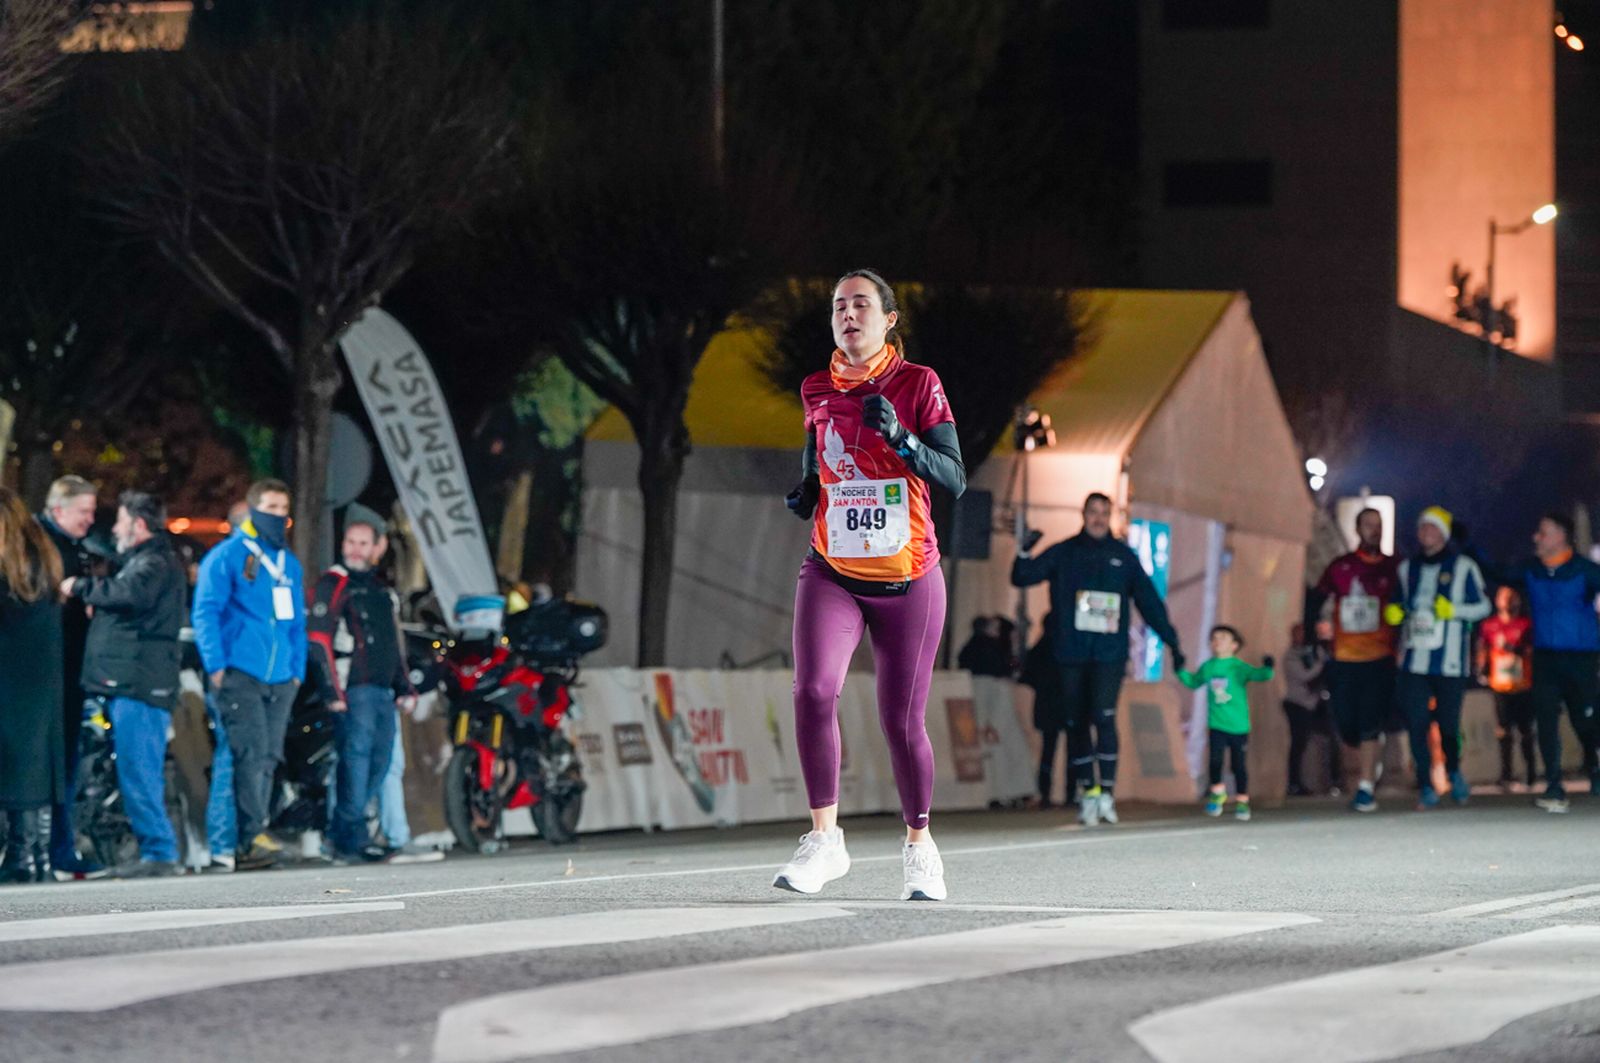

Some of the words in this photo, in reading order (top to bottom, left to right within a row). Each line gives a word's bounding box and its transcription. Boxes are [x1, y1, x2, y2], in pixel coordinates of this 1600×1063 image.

[394, 352, 478, 538] JAPEMASA
[837, 459, 855, 480] 43
[833, 498, 849, 507] SAN
[841, 489, 866, 497] NOCHE
[846, 507, 887, 531] 849
